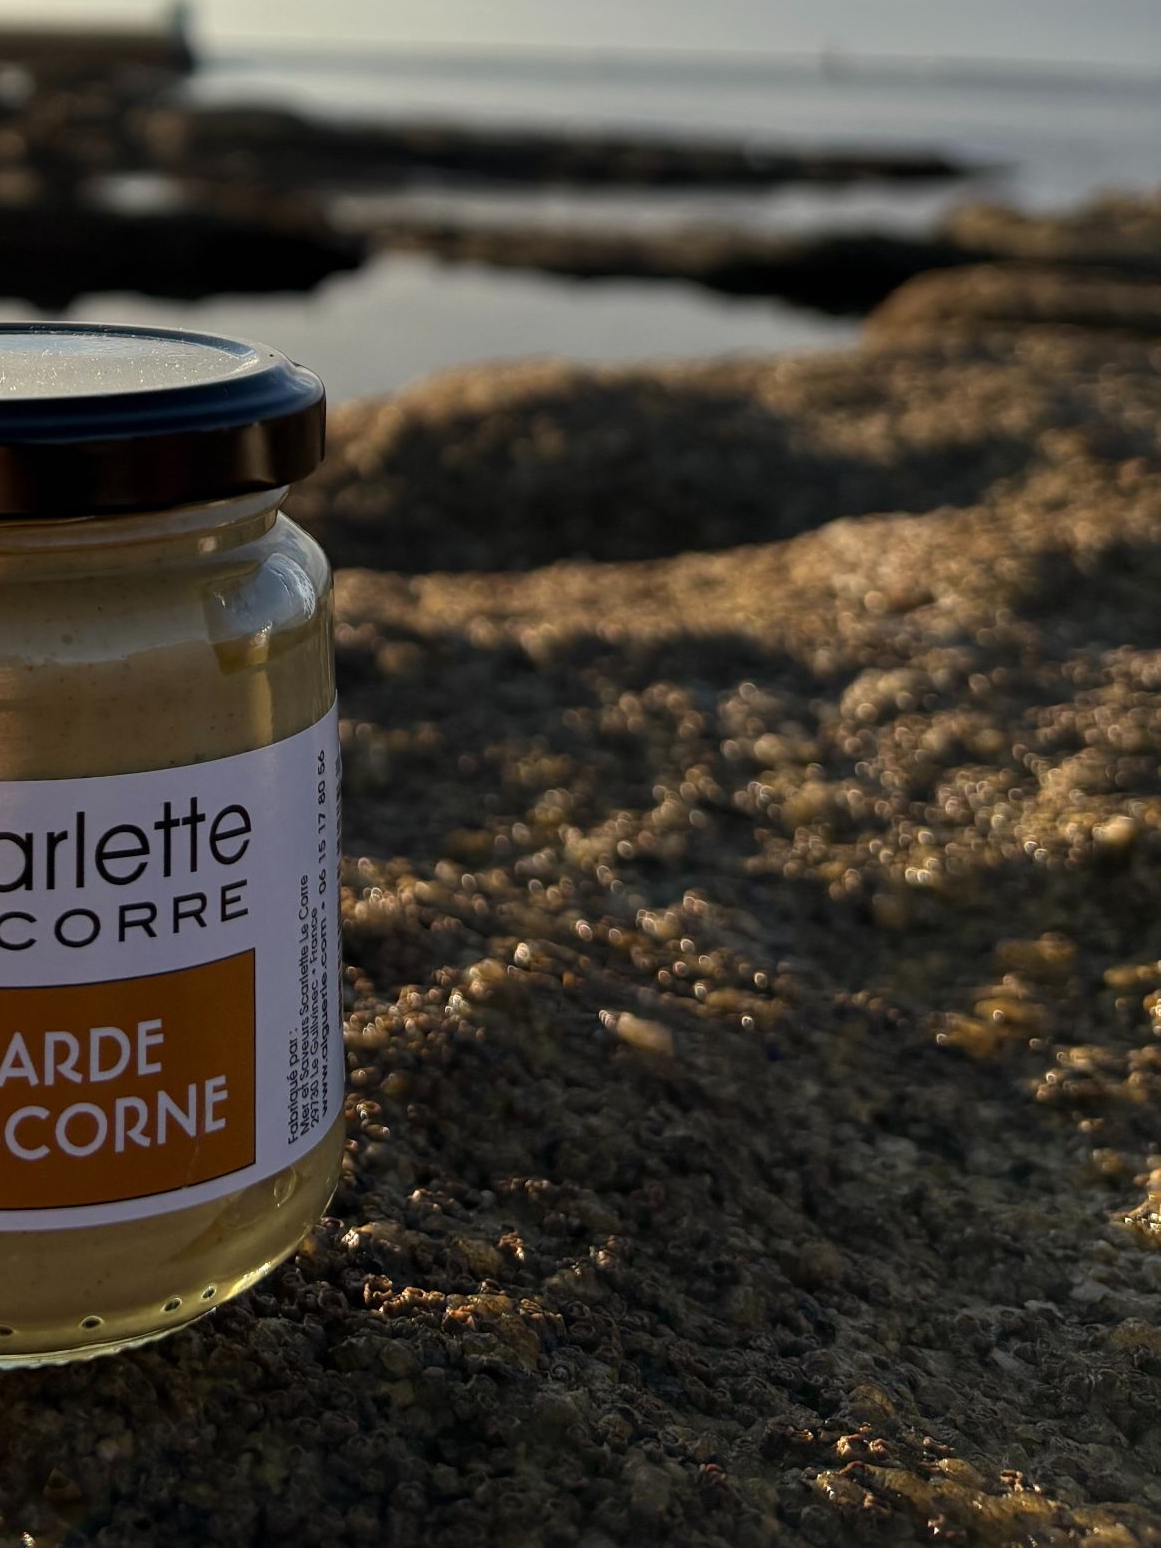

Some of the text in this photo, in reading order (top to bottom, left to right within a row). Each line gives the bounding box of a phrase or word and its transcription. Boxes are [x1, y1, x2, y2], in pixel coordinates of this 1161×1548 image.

[298, 874, 309, 921] Corre
[299, 923, 309, 943] Le
[318, 750, 329, 1117] www.alguerie.com 06 15 17 80 56
[299, 945, 309, 1015] Scarlette
[309, 907, 319, 1128] 29730 Le Guilvinec France
[289, 1038, 300, 1066] par
[300, 1019, 310, 1081] Saveurs
[287, 1069, 303, 1144] Fabriqué
[300, 1104, 310, 1137] Mer
